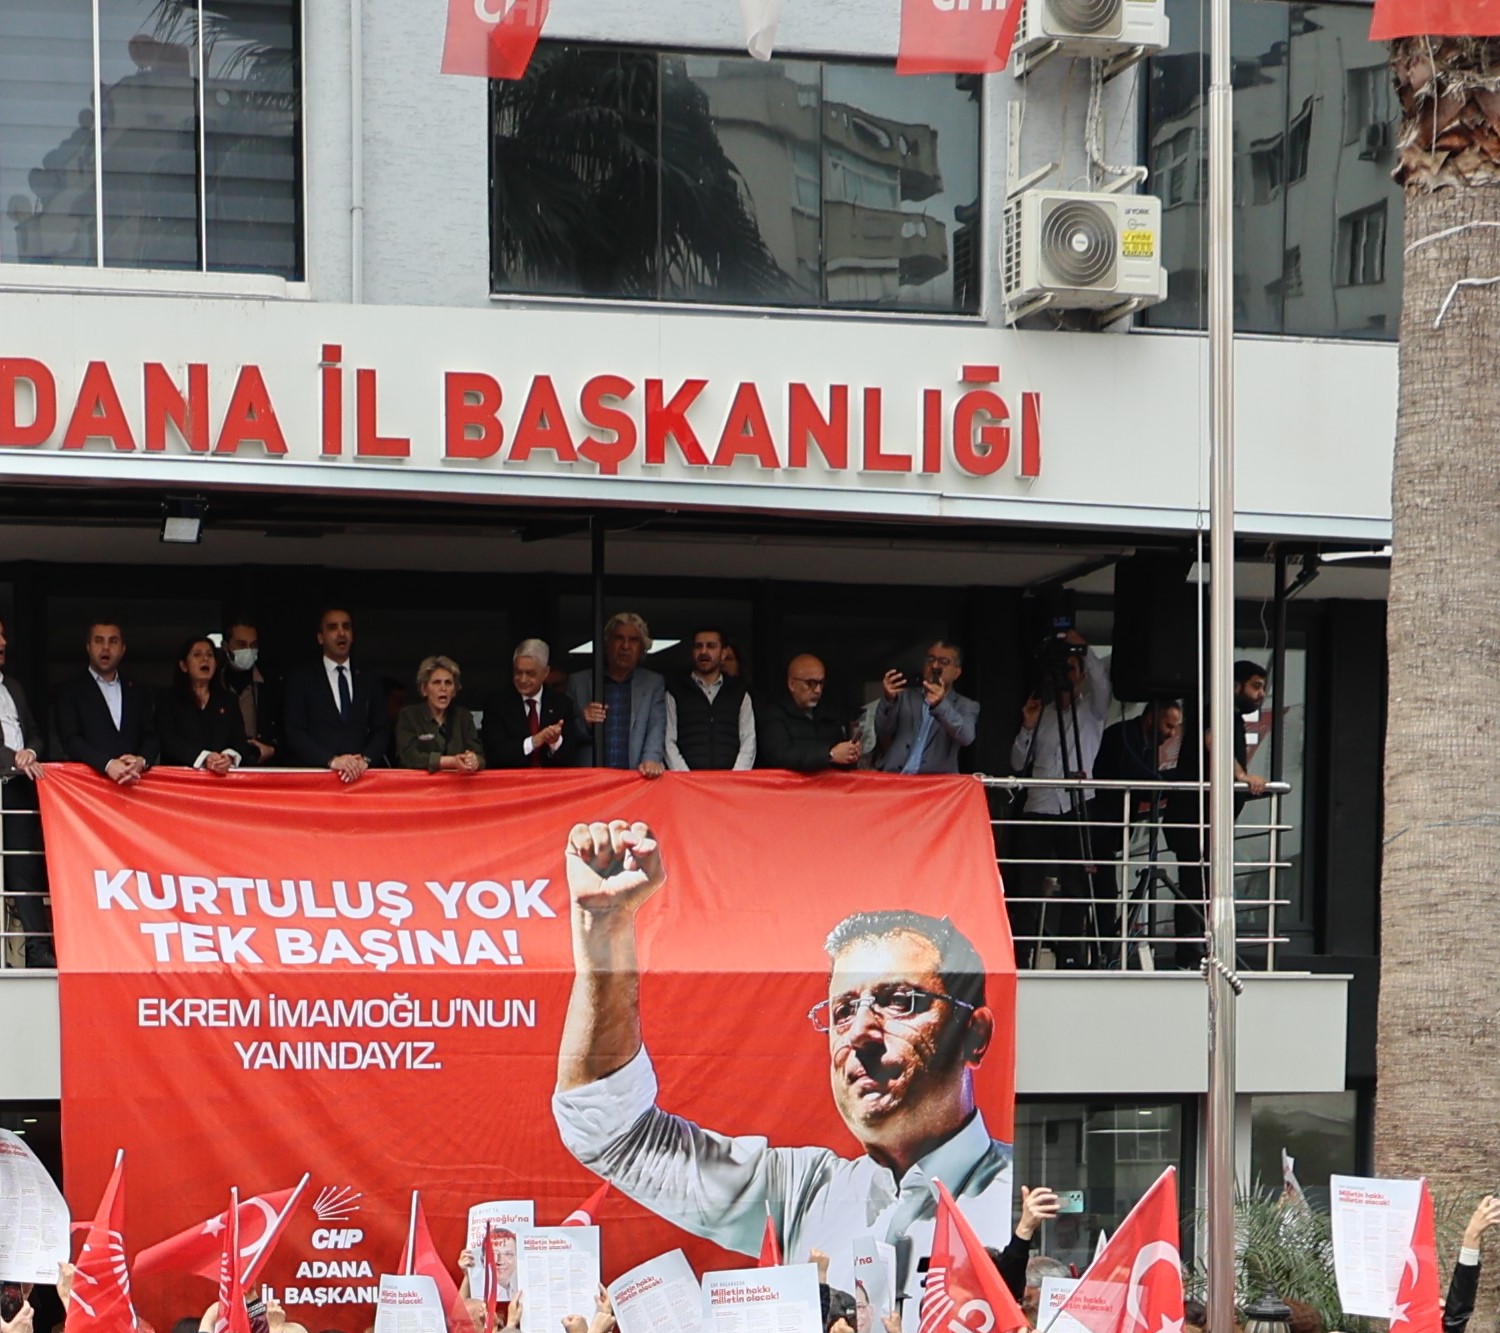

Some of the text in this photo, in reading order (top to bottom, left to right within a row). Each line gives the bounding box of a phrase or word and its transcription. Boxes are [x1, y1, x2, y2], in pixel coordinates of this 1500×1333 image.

[321, 343, 411, 459] İL
[444, 364, 1041, 478] BAŞKANLIĞI
[95, 869, 556, 928] KURTULUŞ YOK
[140, 922, 522, 973] TEK BAŞINA!
[137, 991, 536, 1031] EKREM İMAMOĞLU'NUN
[233, 1039, 442, 1072] YANINDAYIZ.
[311, 1228, 364, 1249] CHP
[295, 1260, 373, 1279] ADANA
[261, 1283, 380, 1307] İL BAŞKANL
